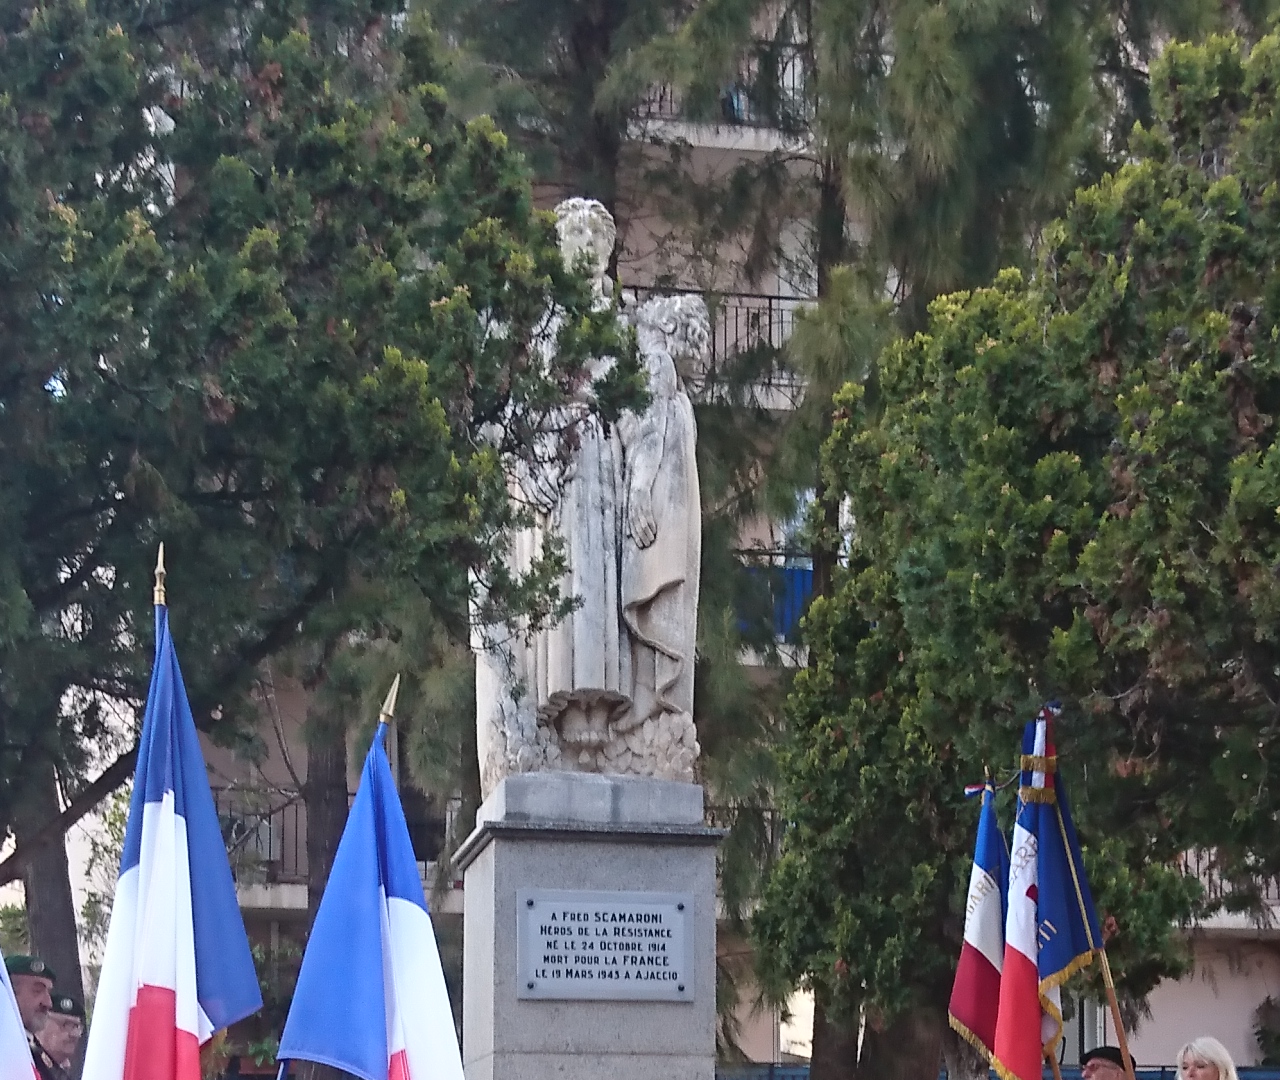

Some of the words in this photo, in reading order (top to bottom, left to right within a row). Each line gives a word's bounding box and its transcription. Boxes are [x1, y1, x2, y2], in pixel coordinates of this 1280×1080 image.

[551, 913, 557, 922] A
[563, 911, 589, 922] FRED
[594, 912, 662, 924] SCAMARONI
[578, 927, 590, 936] DE
[595, 928, 608, 936] LA
[565, 941, 576, 950] LE
[582, 941, 594, 950] 24
[600, 941, 643, 952] OCTOBRE
[648, 943, 666, 952] 1914
[543, 955, 568, 965] MORT
[575, 956, 600, 965] POUR
[605, 956, 617, 965] LA
[623, 955, 669, 966] FRANCE
[536, 969, 547, 979] LE
[552, 969, 561, 979] 19
[566, 968, 593, 979] MARS
[598, 970, 620, 979] 1943
[624, 970, 630, 979] A
[636, 970, 678, 980] AJACCIO
